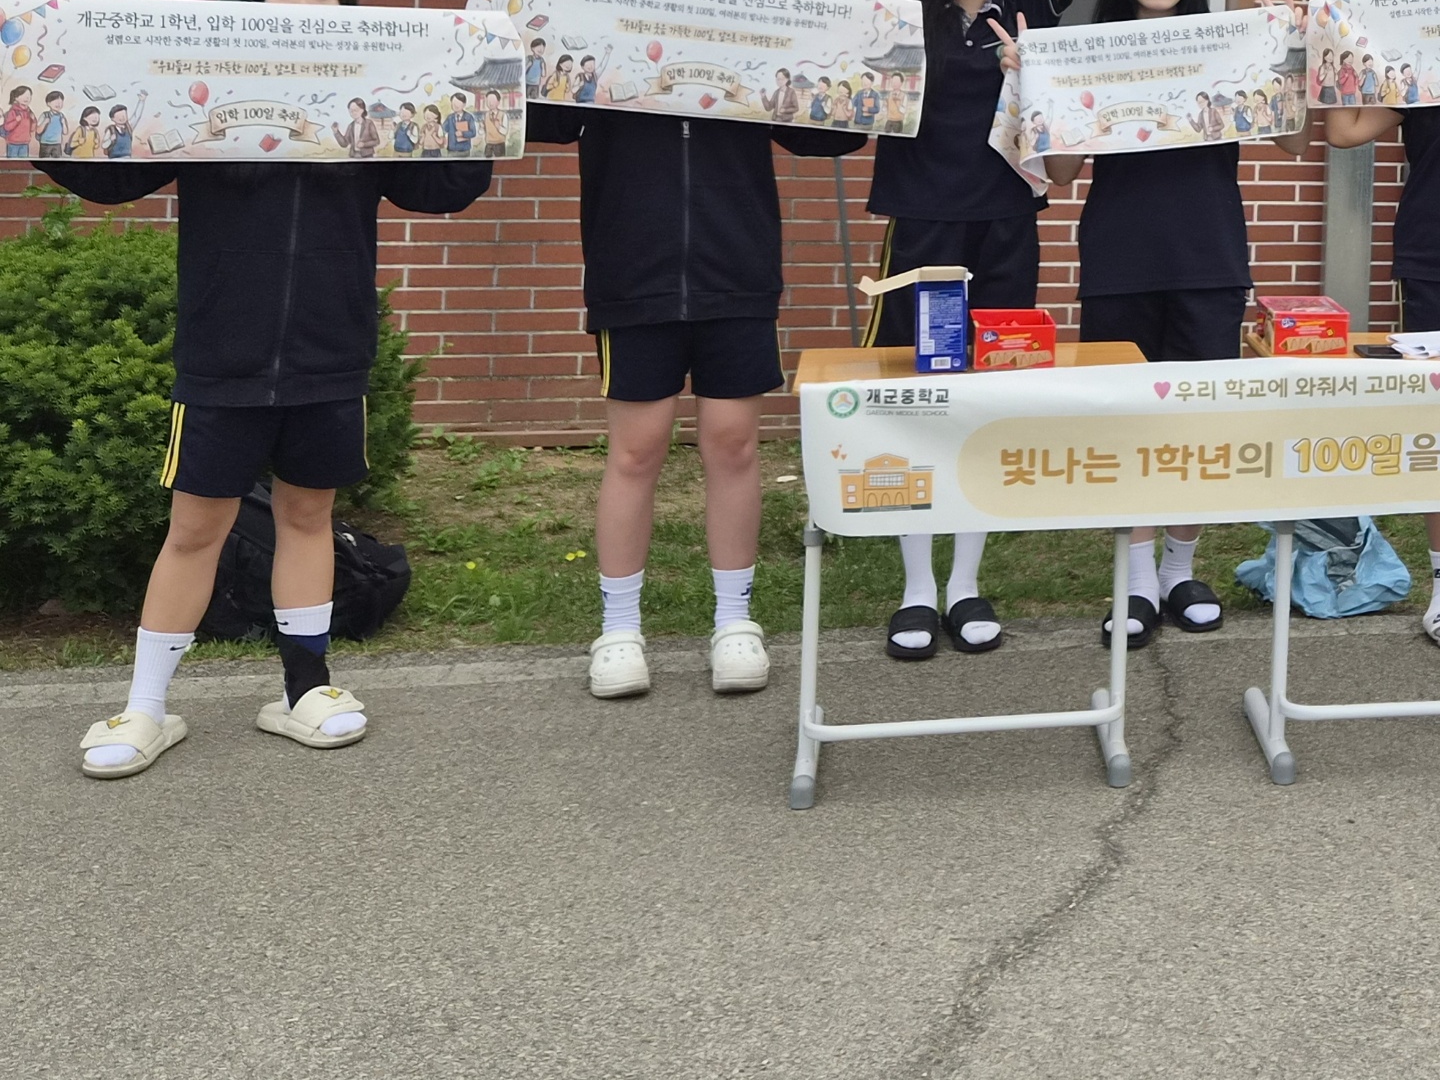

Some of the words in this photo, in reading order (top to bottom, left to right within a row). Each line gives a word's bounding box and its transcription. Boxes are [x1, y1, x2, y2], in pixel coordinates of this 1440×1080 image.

[791, 0, 852, 18] 축하합니다!
[77, 10, 154, 28] 개군중학교
[160, 13, 201, 31] 1학년,
[206, 15, 235, 31] 입학
[241, 17, 292, 33] 100일을
[299, 18, 352, 34] 진심으로
[357, 20, 428, 37] 축하합니다!
[145, 35, 171, 46] 시작한
[173, 36, 200, 46] 중학교
[203, 36, 229, 47] 생활의
[271, 39, 305, 49] 여러분의
[308, 40, 332, 50] 빛나는
[336, 40, 359, 50] 성장을
[1084, 35, 1105, 50] 입학
[1109, 32, 1148, 47] 100일을
[1151, 28, 1191, 44] 진심으로
[1194, 22, 1248, 39] 축하합니다!
[666, 68, 685, 80] 입학
[689, 68, 714, 80] 100일
[716, 72, 735, 86] 축하
[216, 108, 239, 124] 입학
[244, 107, 274, 120] 100일
[278, 108, 300, 124] 축하
[866, 388, 950, 404] 개군중학교
[1174, 380, 1216, 402] 우리
[1224, 378, 1288, 400] 학교에
[1294, 376, 1357, 397] 와줘서
[1364, 373, 1426, 394] 고마워
[1000, 446, 1120, 486] 빛나는
[1136, 442, 1272, 481] 1학년의
